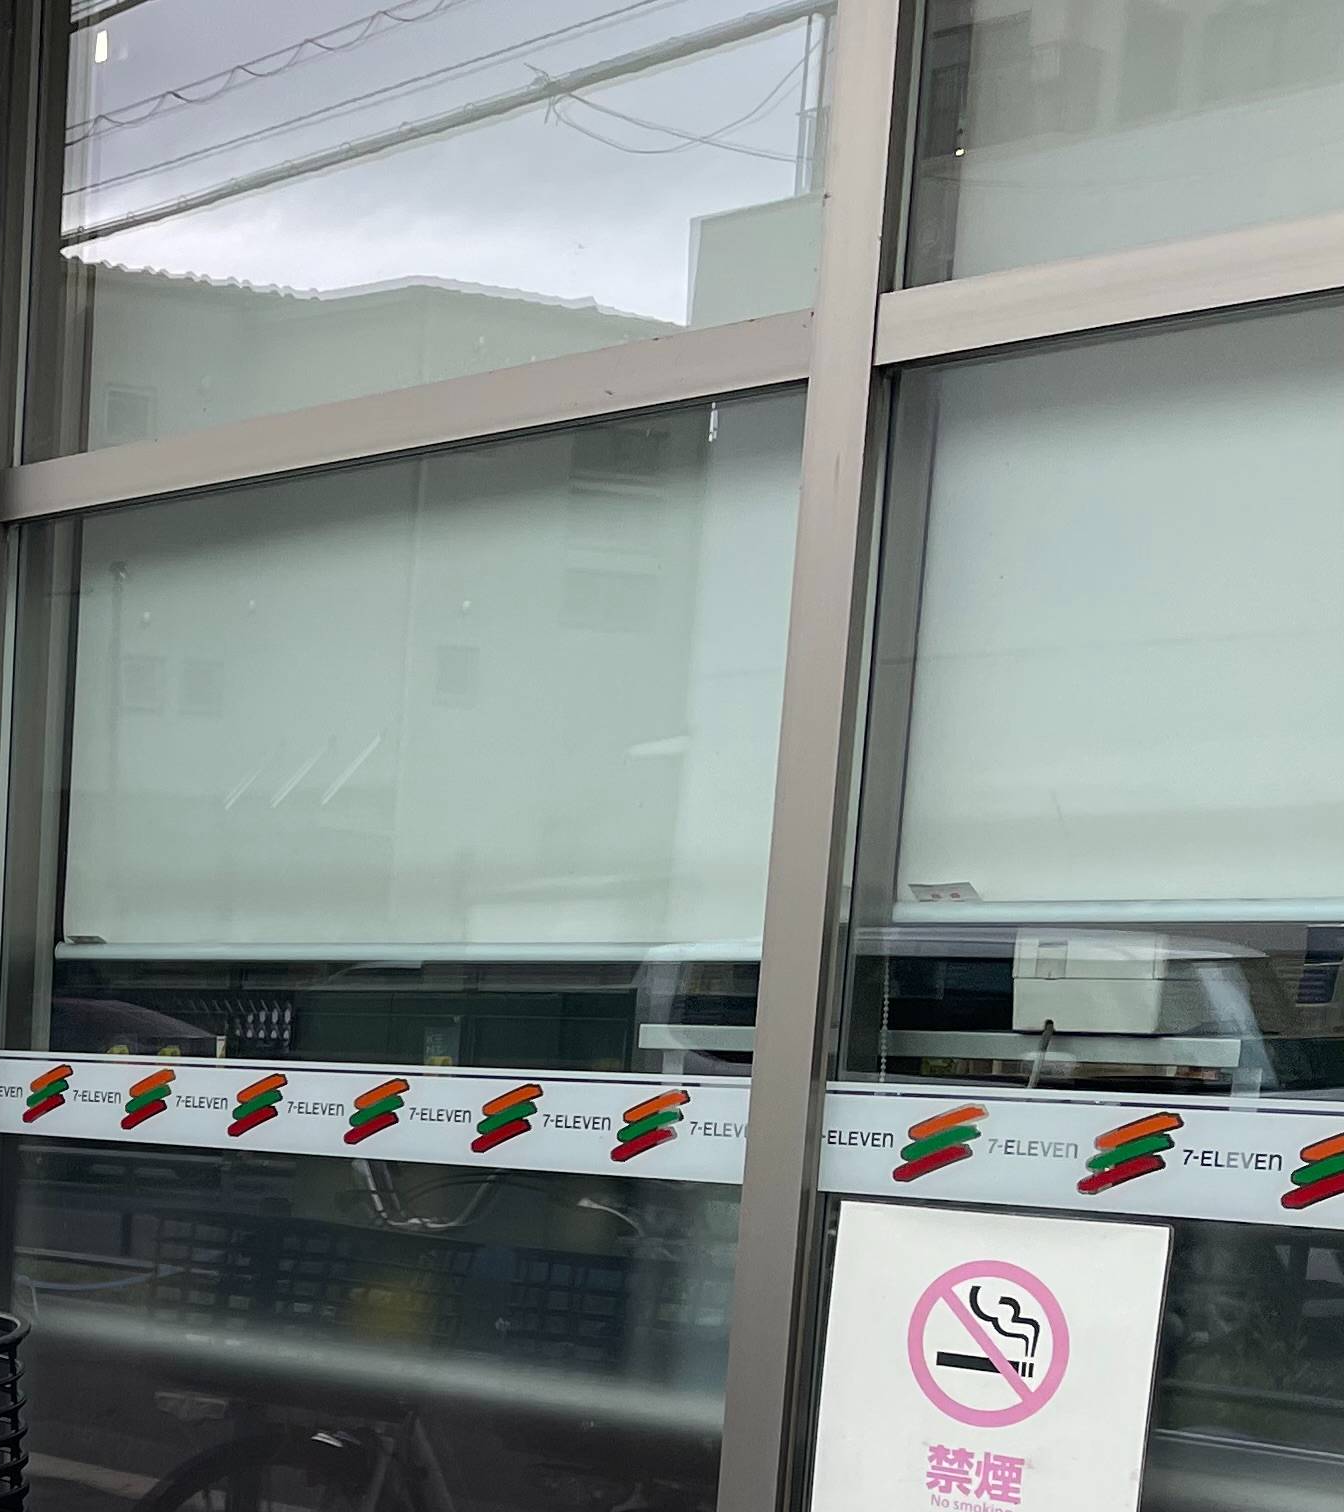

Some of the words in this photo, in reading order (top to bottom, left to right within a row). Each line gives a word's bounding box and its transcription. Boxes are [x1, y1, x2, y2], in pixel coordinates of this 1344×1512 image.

[690, 1121, 748, 1138] 7-ELEV
[926, 1444, 1025, 1505] 禁煙
[930, 1493, 950, 1508] No
